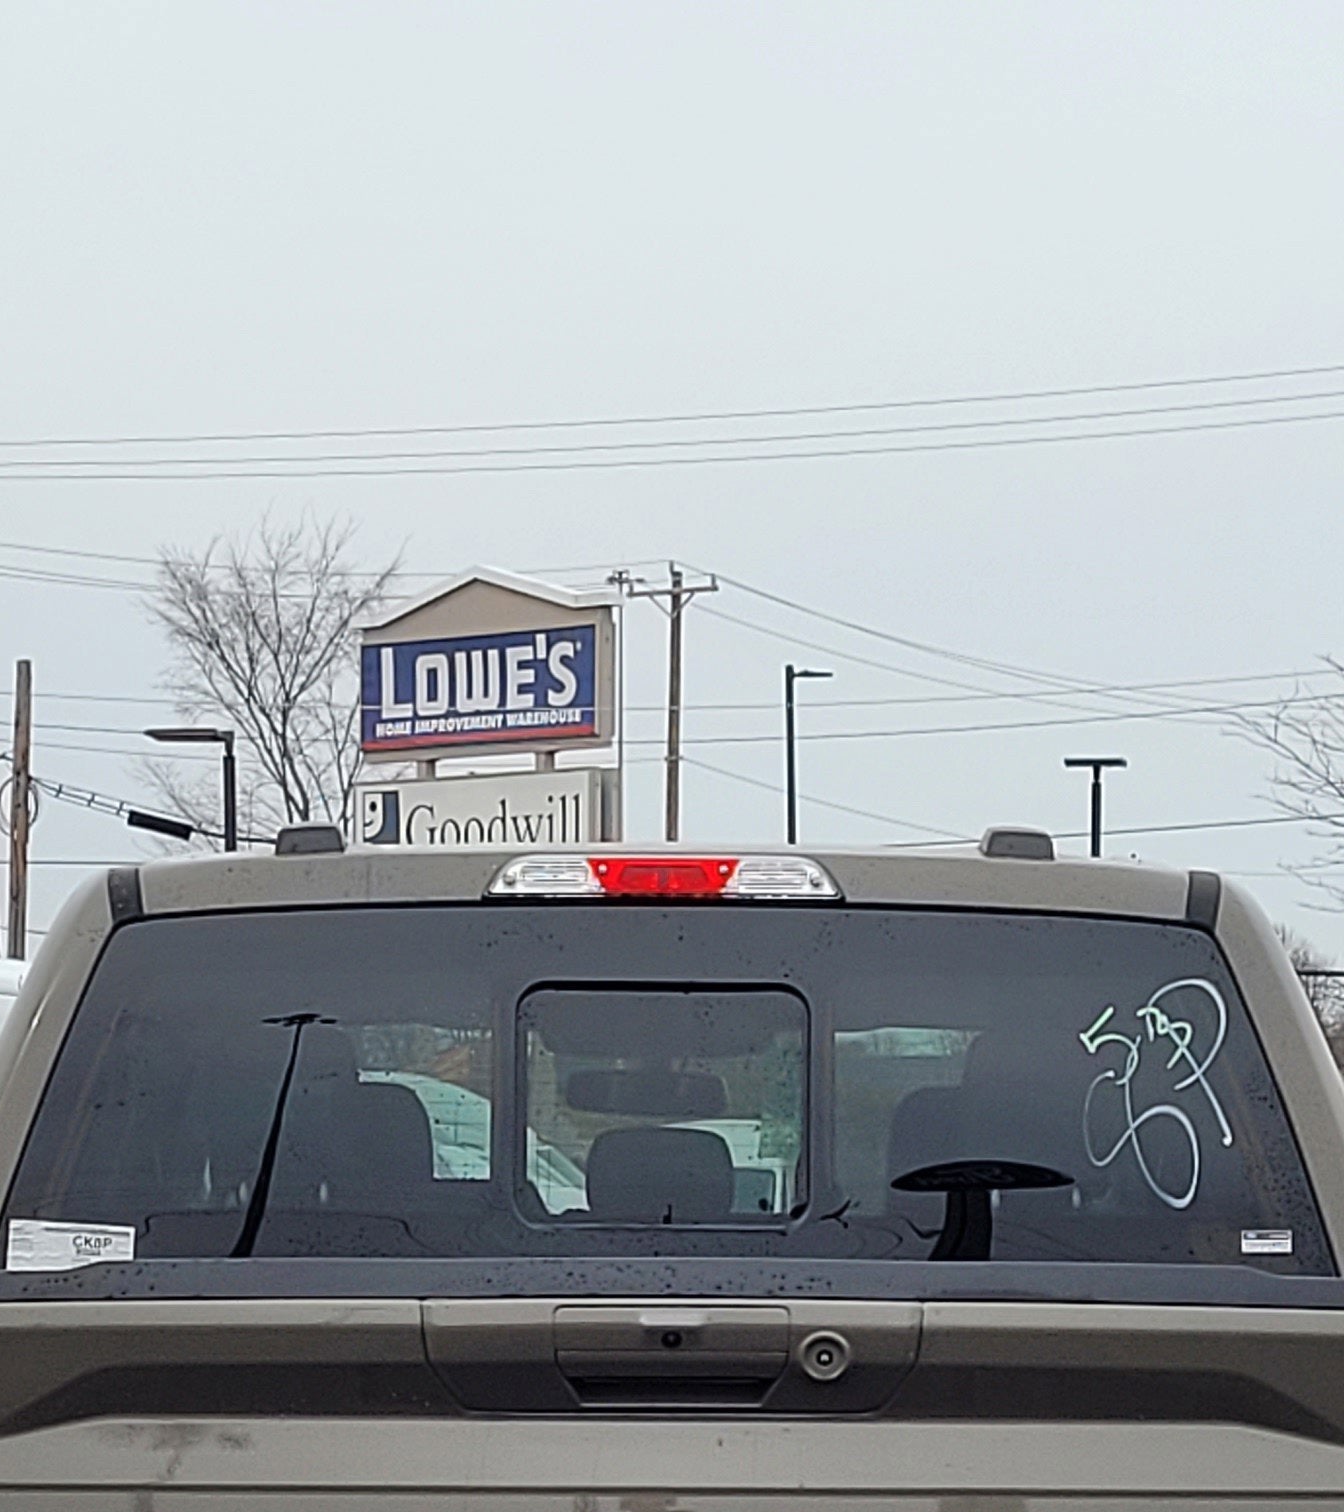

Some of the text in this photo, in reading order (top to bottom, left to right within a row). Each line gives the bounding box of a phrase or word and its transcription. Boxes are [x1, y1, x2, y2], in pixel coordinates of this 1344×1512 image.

[381, 633, 578, 720] LOWE'S
[375, 709, 582, 738] HOME IMPROVEMENT WAREHOUSE
[406, 793, 581, 845] Goodwill
